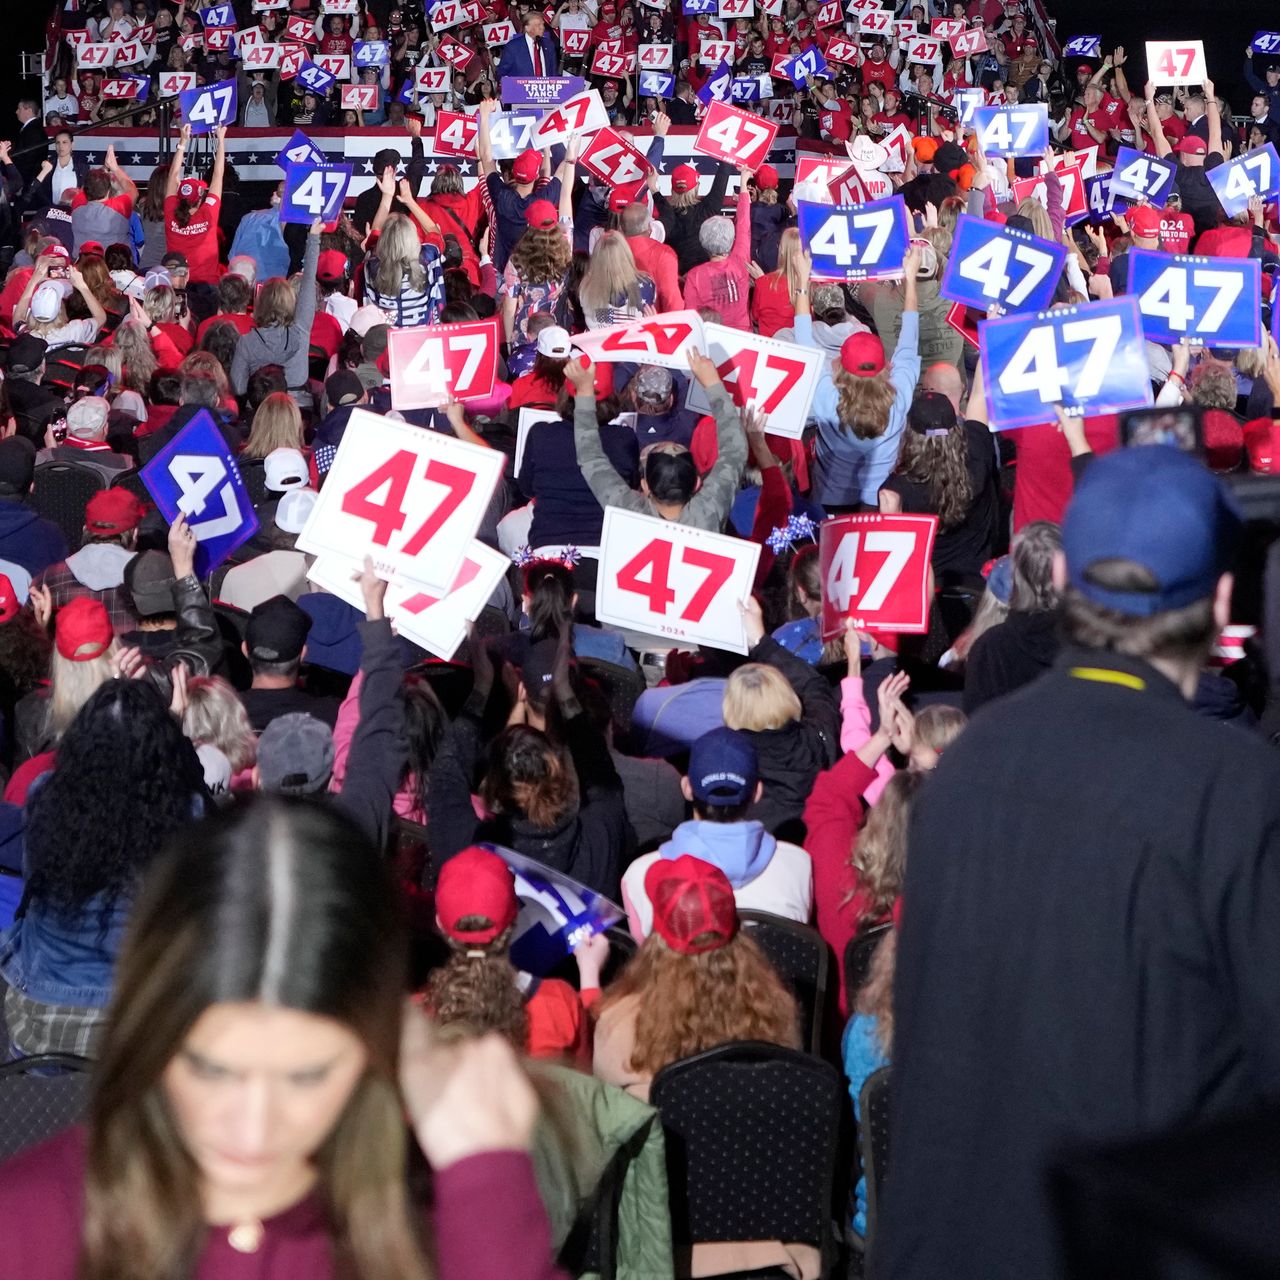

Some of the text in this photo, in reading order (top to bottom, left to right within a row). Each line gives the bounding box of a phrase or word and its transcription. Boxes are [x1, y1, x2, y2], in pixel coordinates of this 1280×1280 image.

[488, 25, 509, 42] 47
[862, 13, 887, 30] 47
[81, 48, 108, 63] 47
[642, 48, 668, 64] 47
[830, 42, 856, 60] 47
[1071, 38, 1096, 51] 47
[301, 68, 331, 88] 47
[420, 71, 445, 88] 47
[1156, 48, 1195, 77] 47
[189, 92, 233, 124] 47
[539, 97, 591, 135] 47
[708, 115, 769, 158] 47
[983, 112, 1039, 148] 47
[1120, 158, 1171, 192] 47
[1225, 152, 1270, 192] 47
[291, 169, 346, 213] 47
[810, 208, 894, 264] 47
[1160, 220, 1184, 230] 024
[960, 237, 1053, 306] 47
[1138, 267, 1243, 332] 47
[403, 334, 486, 390] 47
[999, 315, 1122, 402] 47
[717, 348, 806, 417] 47
[1063, 406, 1084, 417] 024
[342, 450, 476, 556] 47
[616, 538, 735, 622] 47
[828, 531, 916, 610] 47
[660, 625, 686, 636] 2024
